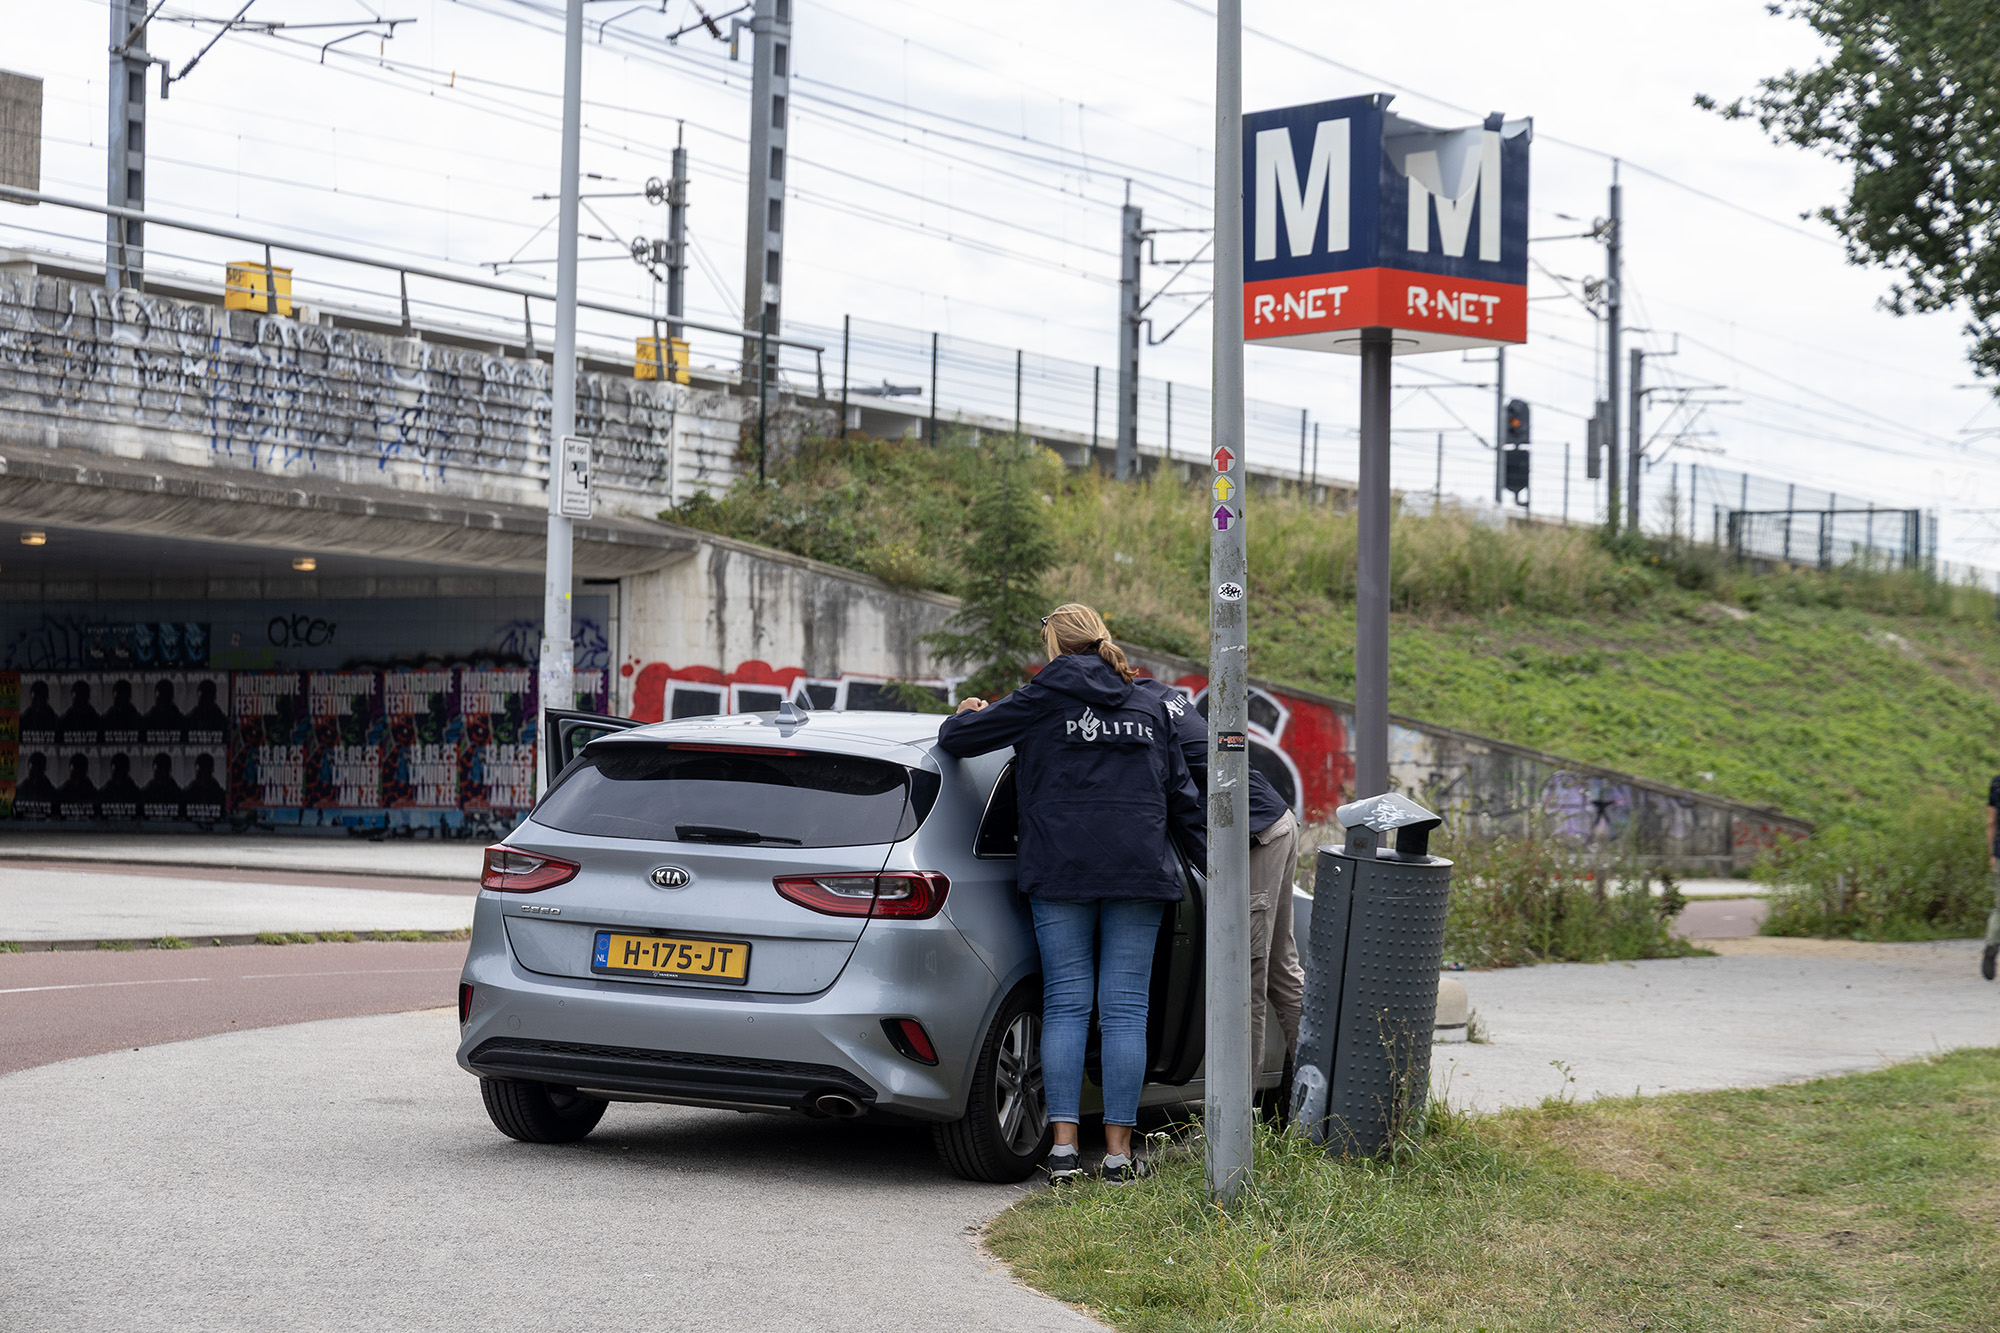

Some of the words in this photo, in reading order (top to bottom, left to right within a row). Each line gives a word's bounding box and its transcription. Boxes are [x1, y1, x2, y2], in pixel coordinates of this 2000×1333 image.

[1255, 118, 1350, 262] M
[1406, 129, 1501, 263] M
[236, 675, 301, 695] MULTIGROOVE
[310, 675, 376, 695] MULTIGROOVE
[384, 672, 454, 693] MULTIGROOVE
[461, 672, 531, 694] MULTIGROOVE
[236, 695, 278, 716] FESTIVAL
[310, 695, 353, 715] FESTIVAL
[385, 694, 430, 714] FESTIVAL
[461, 694, 506, 714] FESTIVAL
[1066, 707, 1154, 742] POLITIE
[259, 745, 304, 765] 13.09.25
[333, 745, 379, 766] 13.09.25
[410, 744, 457, 764] 13.09.25
[486, 744, 533, 764] 13.09.25
[264, 786, 284, 806] AAN
[286, 786, 303, 806] ZEE
[339, 786, 359, 806] AAN
[361, 786, 378, 806] ZEE
[416, 786, 437, 807] AAN
[439, 786, 456, 807] ZEE
[491, 786, 512, 807] AAN
[513, 786, 531, 807] ZEE
[656, 871, 682, 885] KIA
[596, 954, 606, 963] NL
[623, 940, 733, 973] H-175-JT
